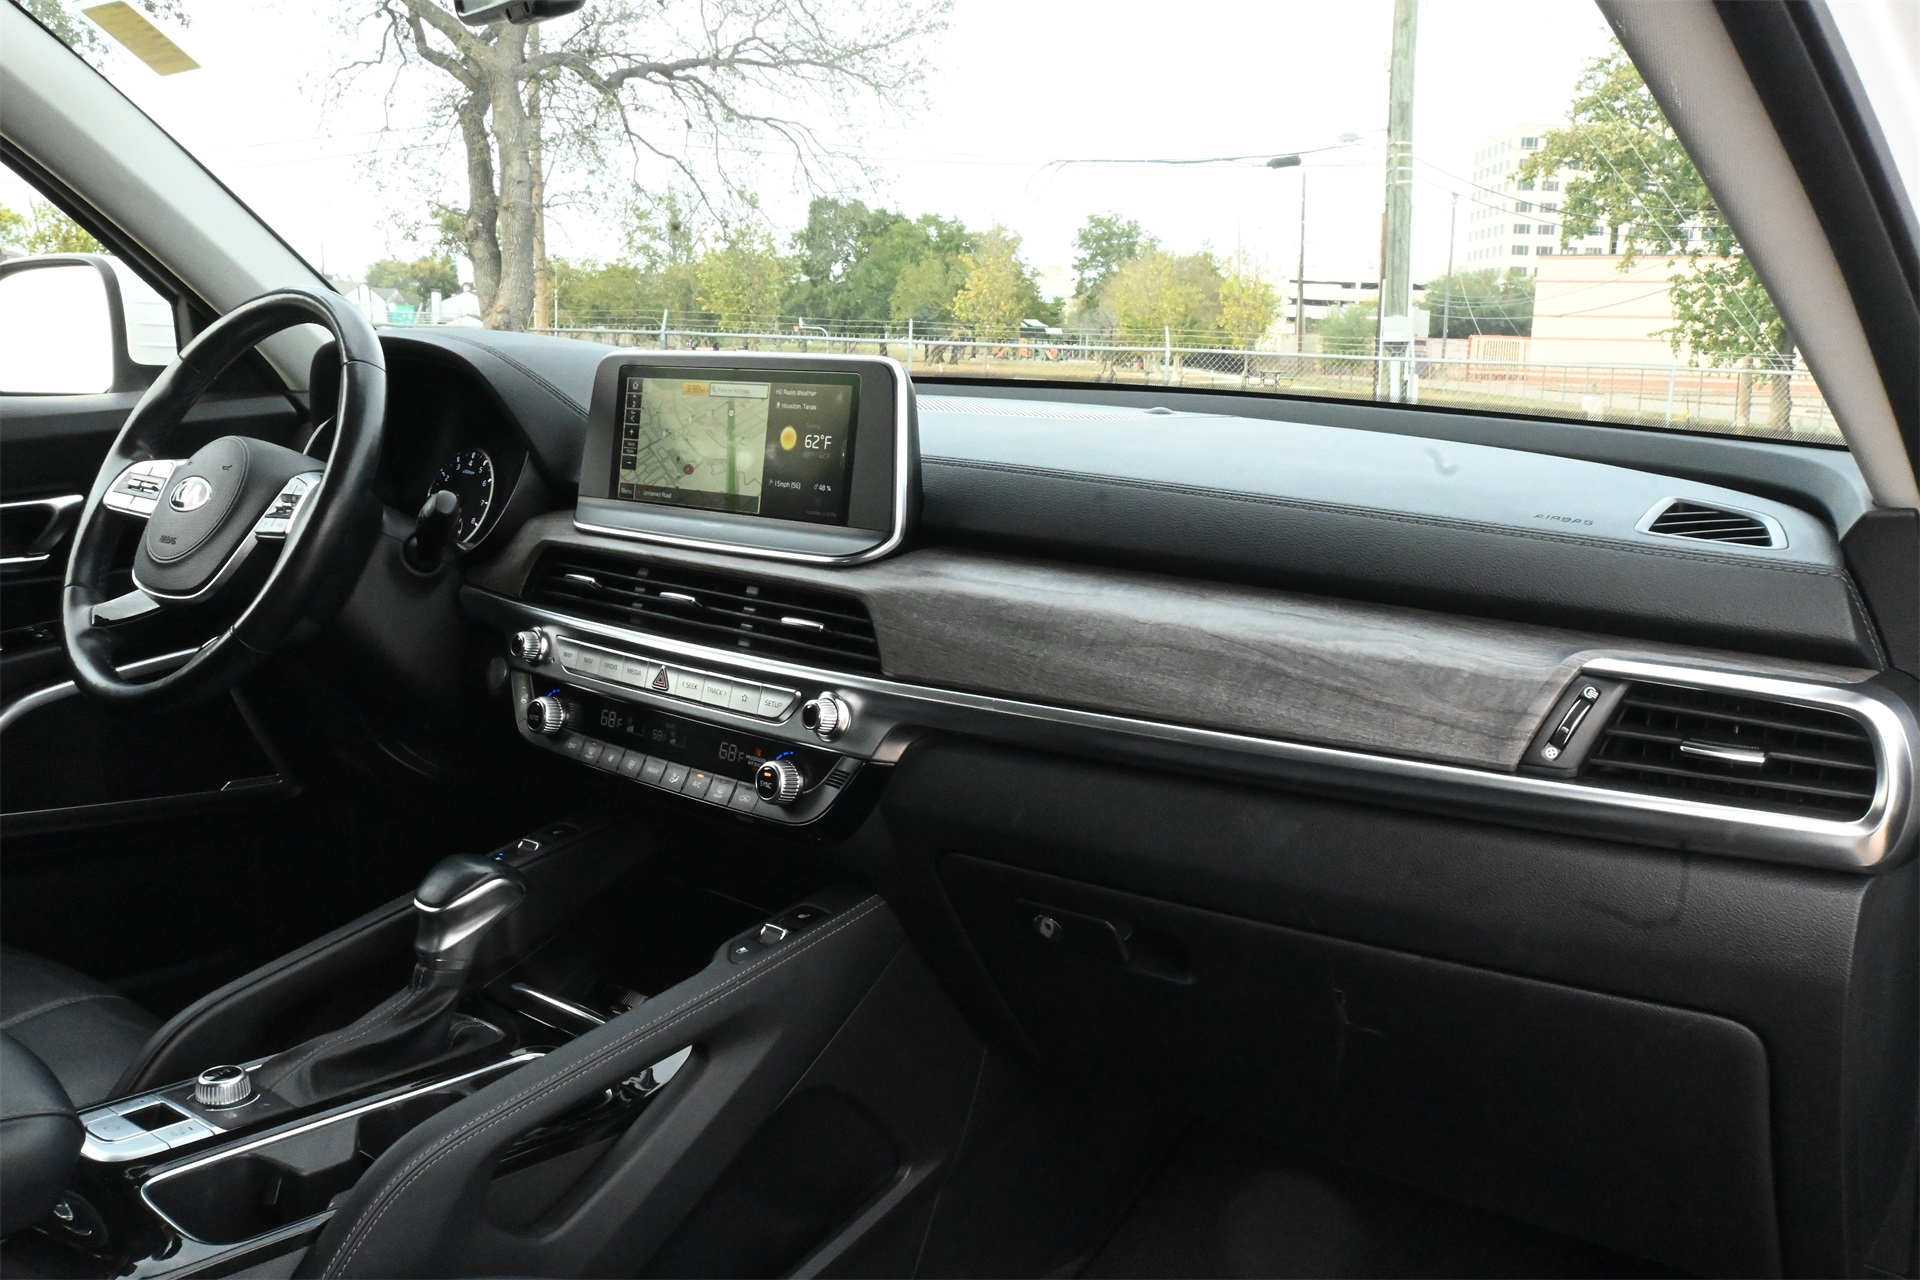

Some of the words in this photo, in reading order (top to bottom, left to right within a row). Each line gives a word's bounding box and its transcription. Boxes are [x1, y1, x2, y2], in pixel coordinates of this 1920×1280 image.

[804, 434, 832, 450] 62°F
[444, 474, 450, 482] 2
[470, 517, 476, 525] 8
[1533, 513, 1594, 526] AIRBAG
[627, 668, 642, 676] MEDIA
[707, 686, 723, 696] TRACK
[764, 699, 783, 709] SETUP
